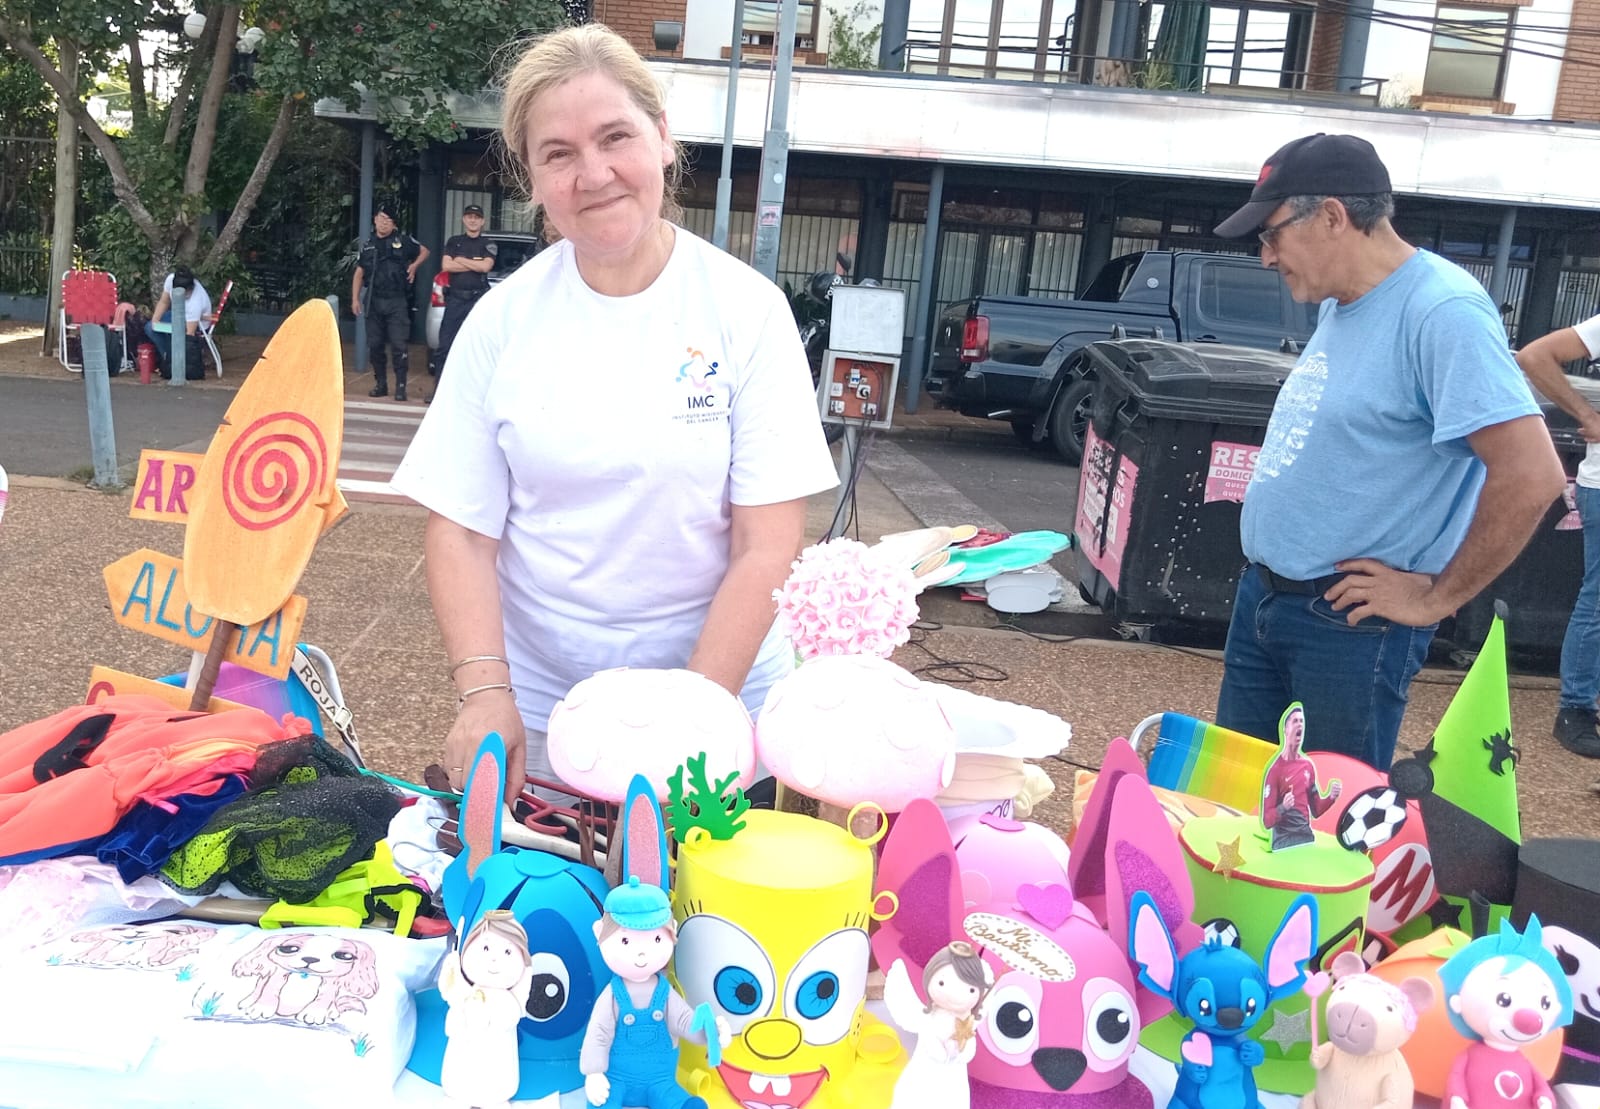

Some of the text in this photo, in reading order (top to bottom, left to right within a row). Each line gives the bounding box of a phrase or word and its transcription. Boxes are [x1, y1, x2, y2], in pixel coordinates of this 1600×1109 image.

[687, 395, 715, 409] IMC
[1370, 847, 1432, 924] M
[966, 921, 1063, 977] Bautismo
